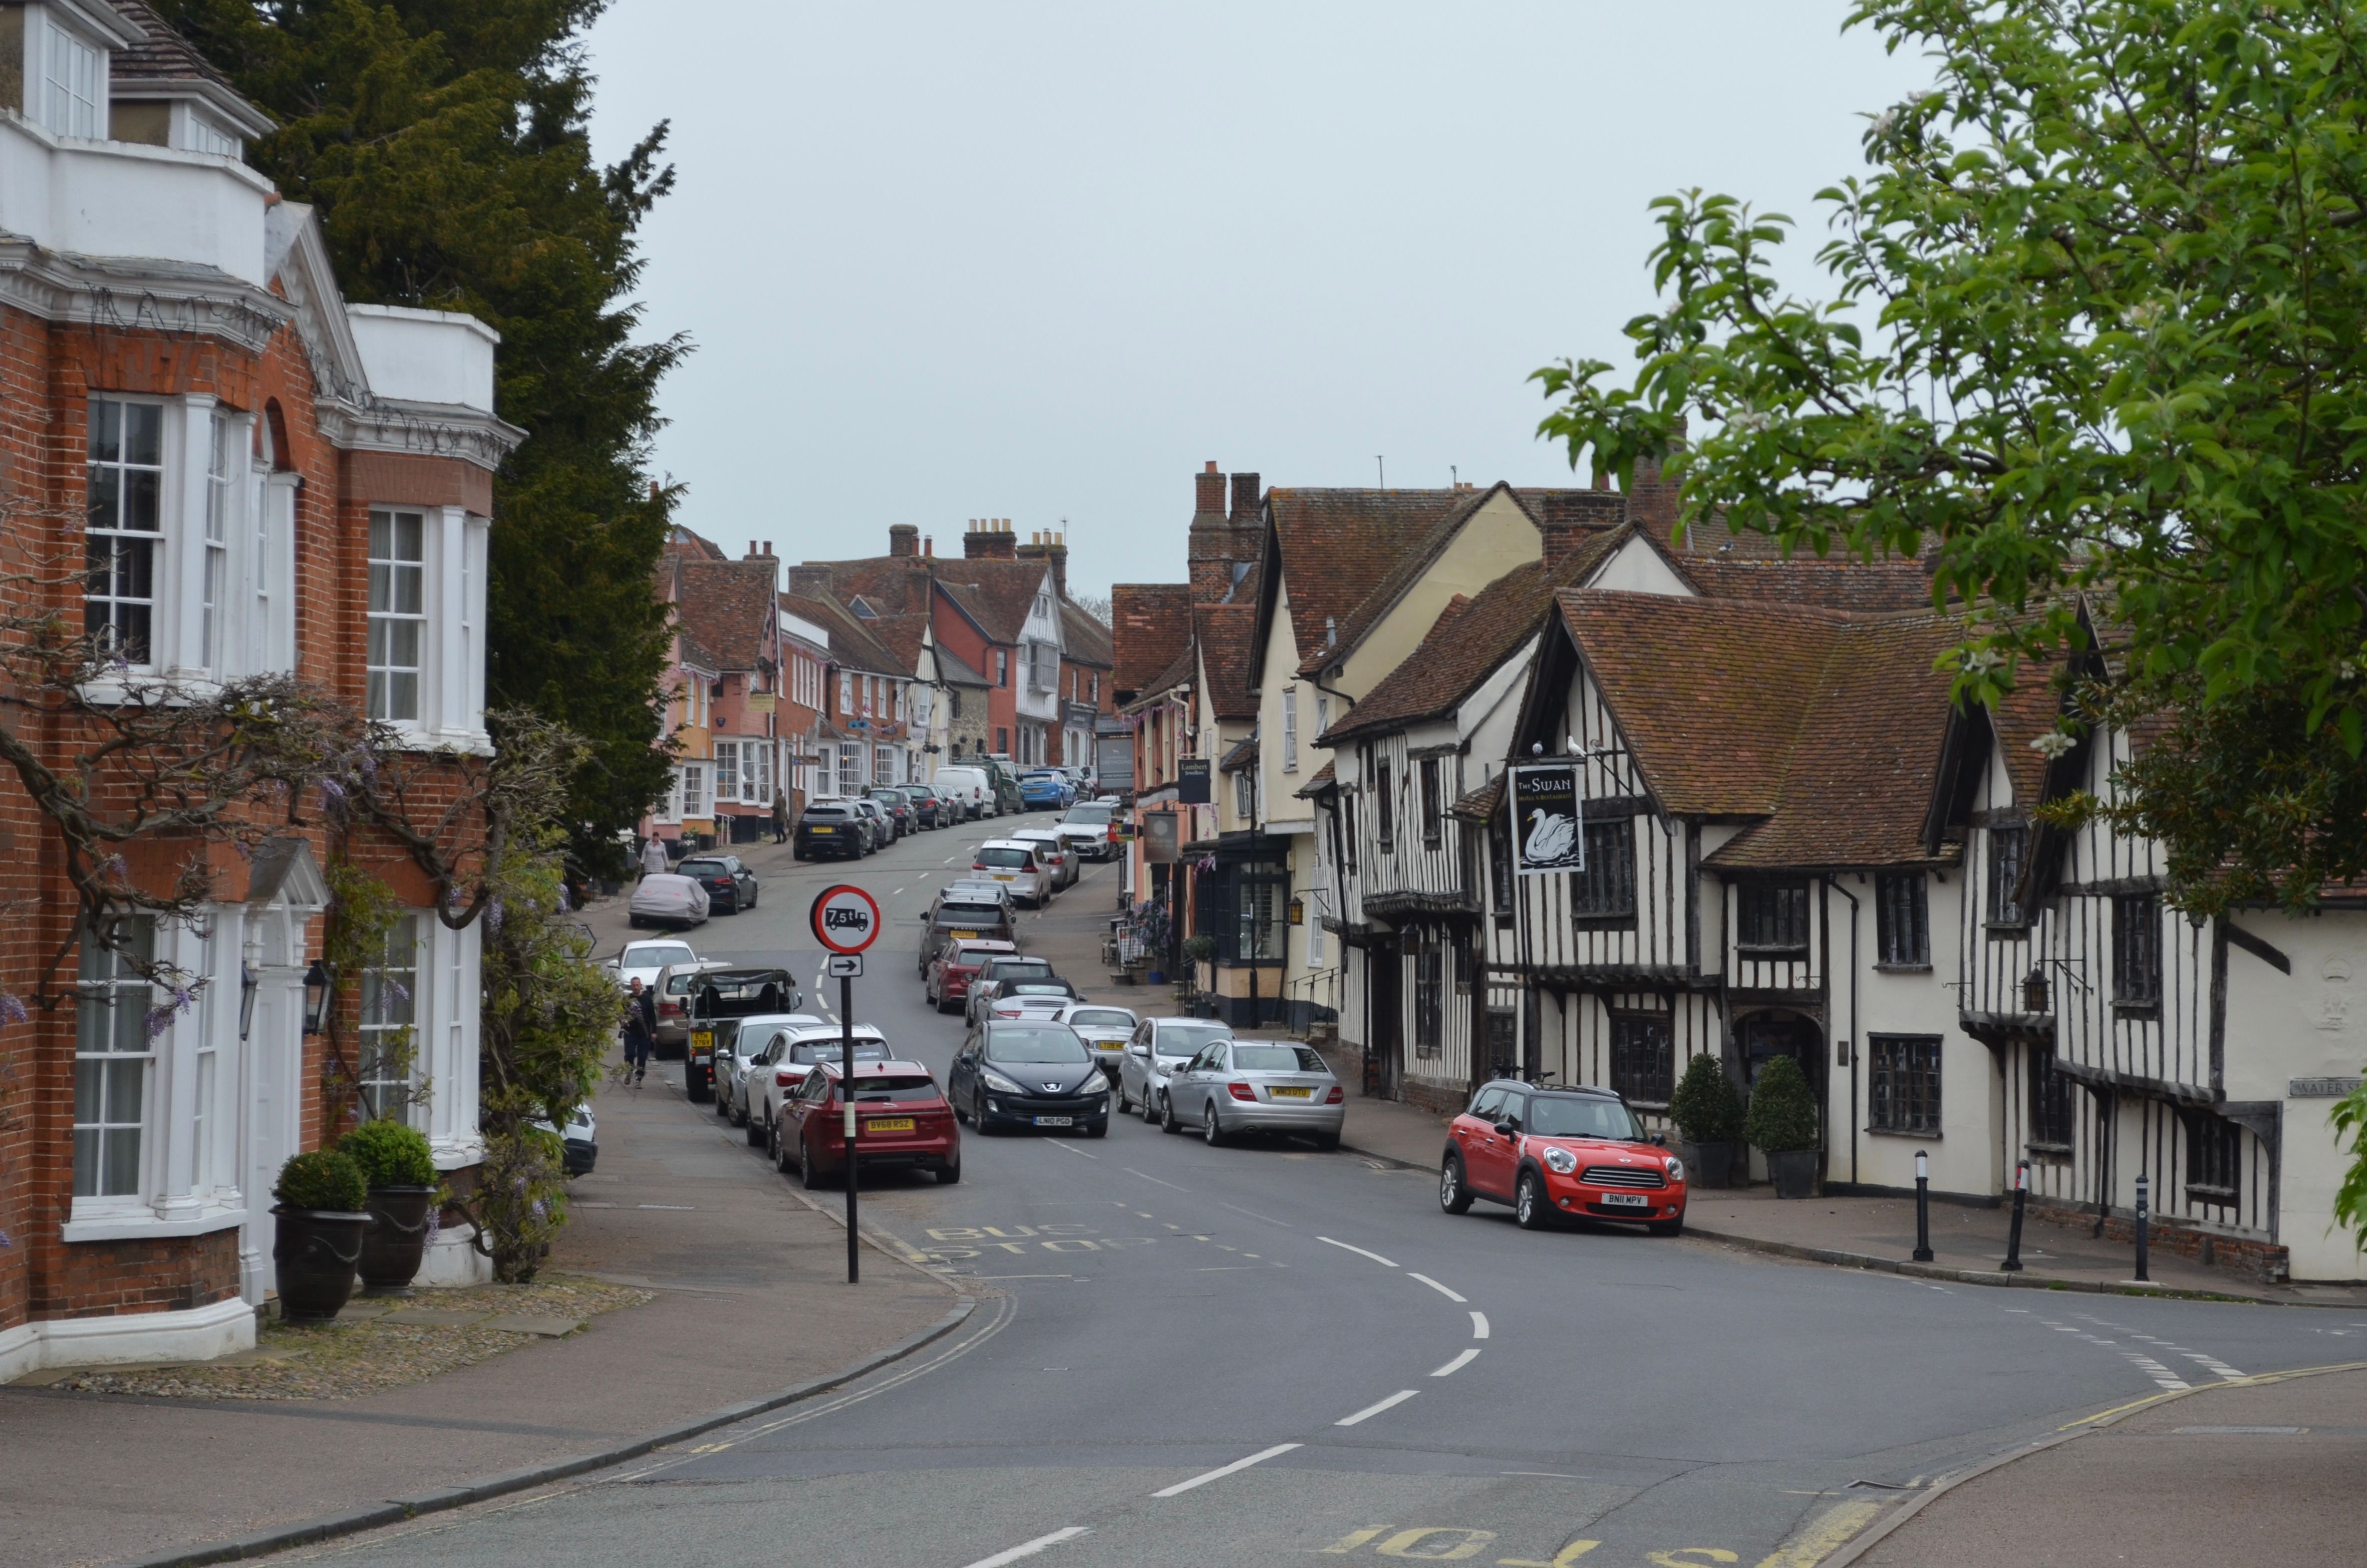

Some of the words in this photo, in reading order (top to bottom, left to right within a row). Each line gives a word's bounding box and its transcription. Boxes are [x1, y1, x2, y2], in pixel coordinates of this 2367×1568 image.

[2298, 1083, 2343, 1093] WATER
[1609, 1195, 1624, 1203] BN11
[1626, 1196, 1642, 1205] MPV
[926, 1224, 1100, 1241] BUS
[920, 1237, 1158, 1260] STOP
